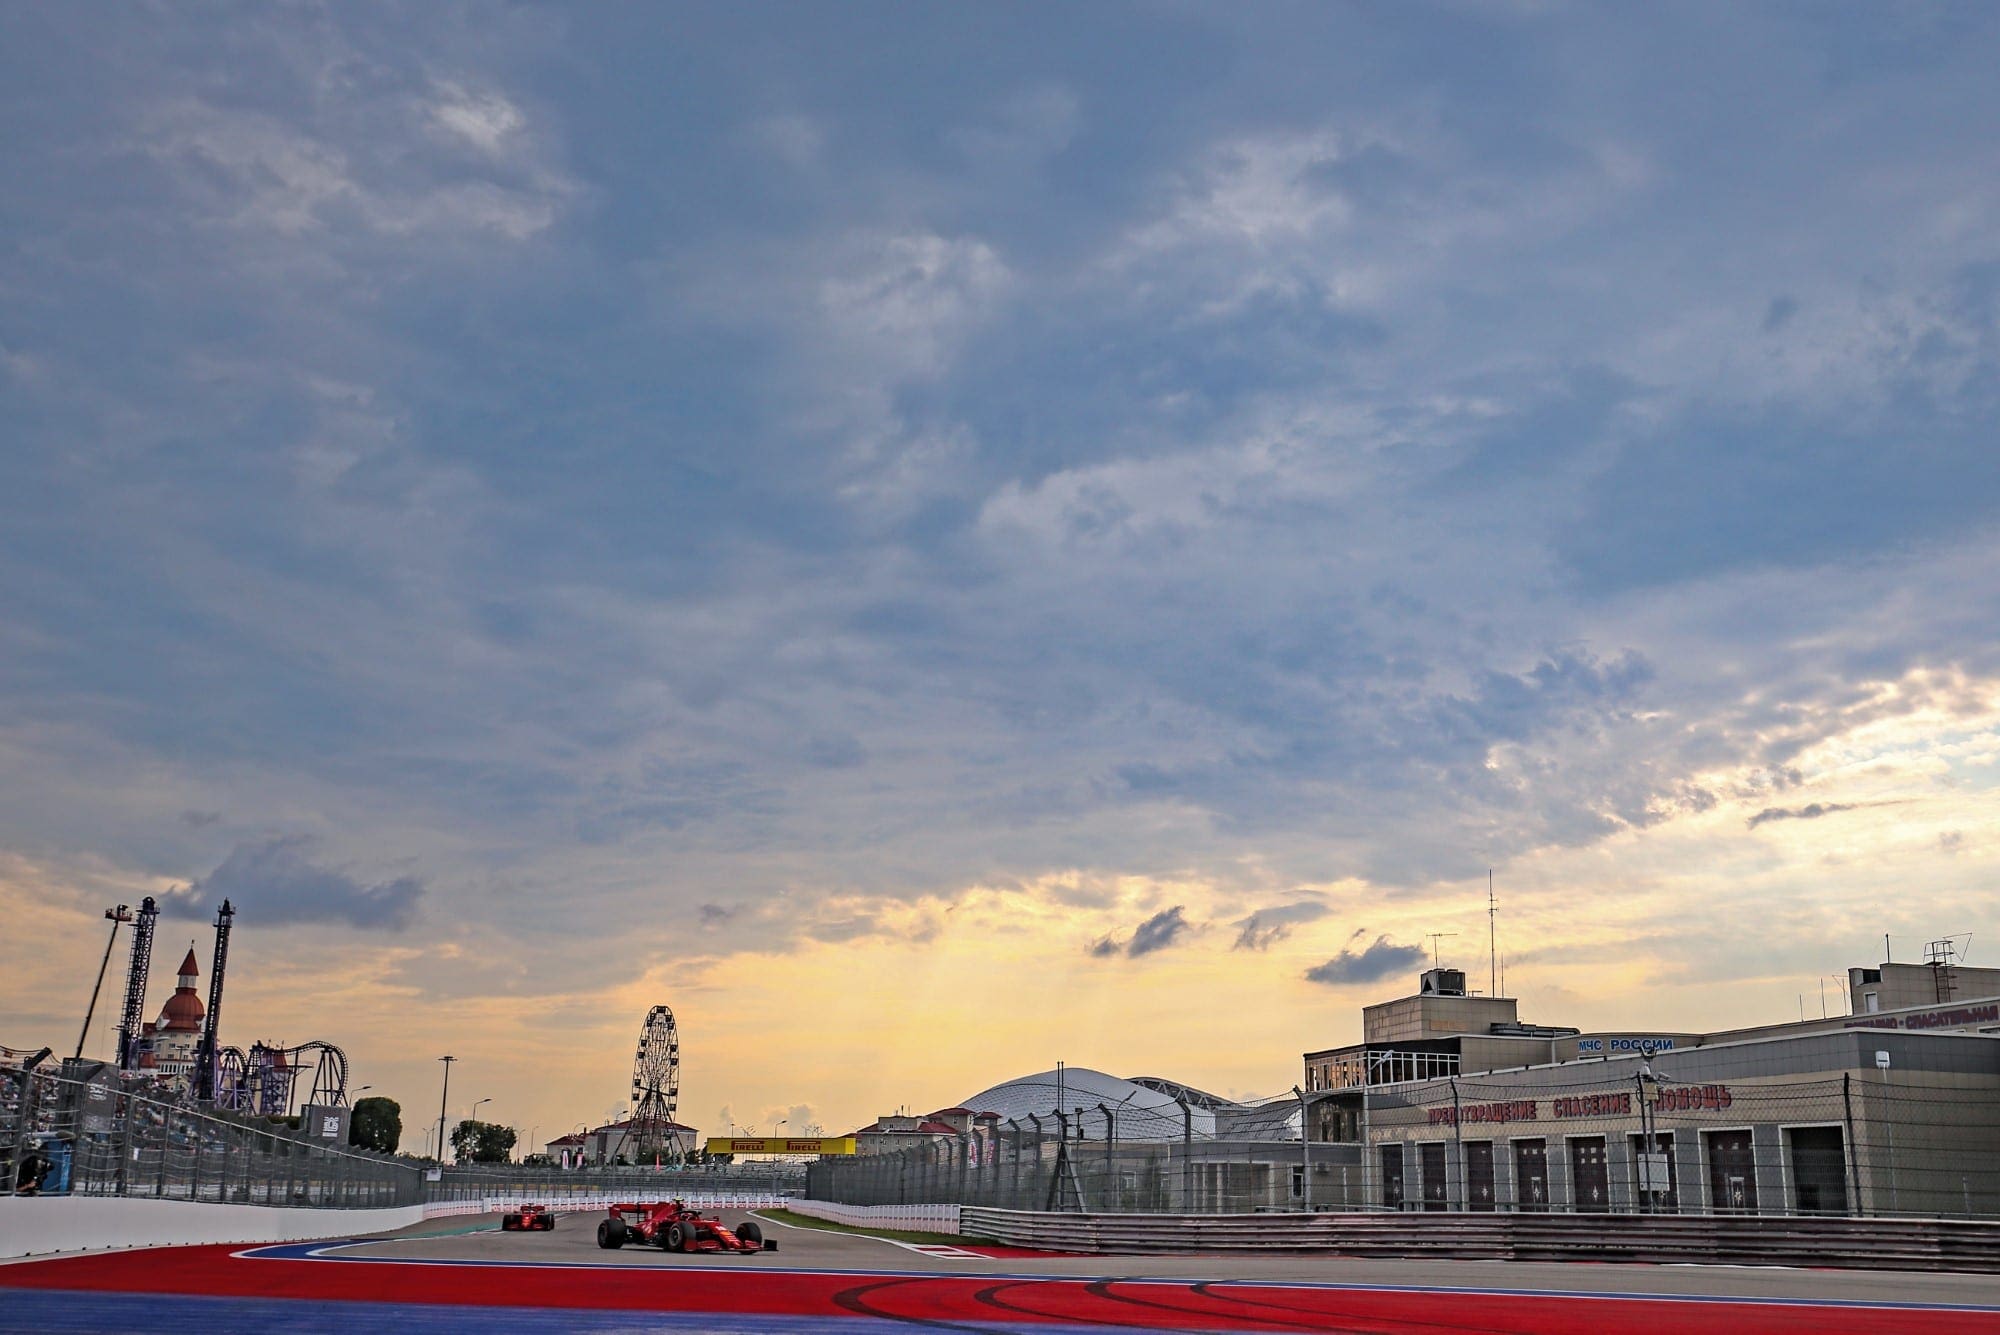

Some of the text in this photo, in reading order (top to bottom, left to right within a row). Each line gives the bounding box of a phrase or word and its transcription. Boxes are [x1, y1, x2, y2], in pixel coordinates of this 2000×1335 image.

[1905, 1004, 1998, 1030] СПАСАТЕЛЬНАЯ
[1578, 1039, 1674, 1052] МЧС РОССИИ
[1553, 1092, 1632, 1118] СПАСЕНИЕ
[1653, 1084, 1733, 1112] ПОМОЩЬ
[731, 1140, 822, 1151] PIRELLI PIRELLI
